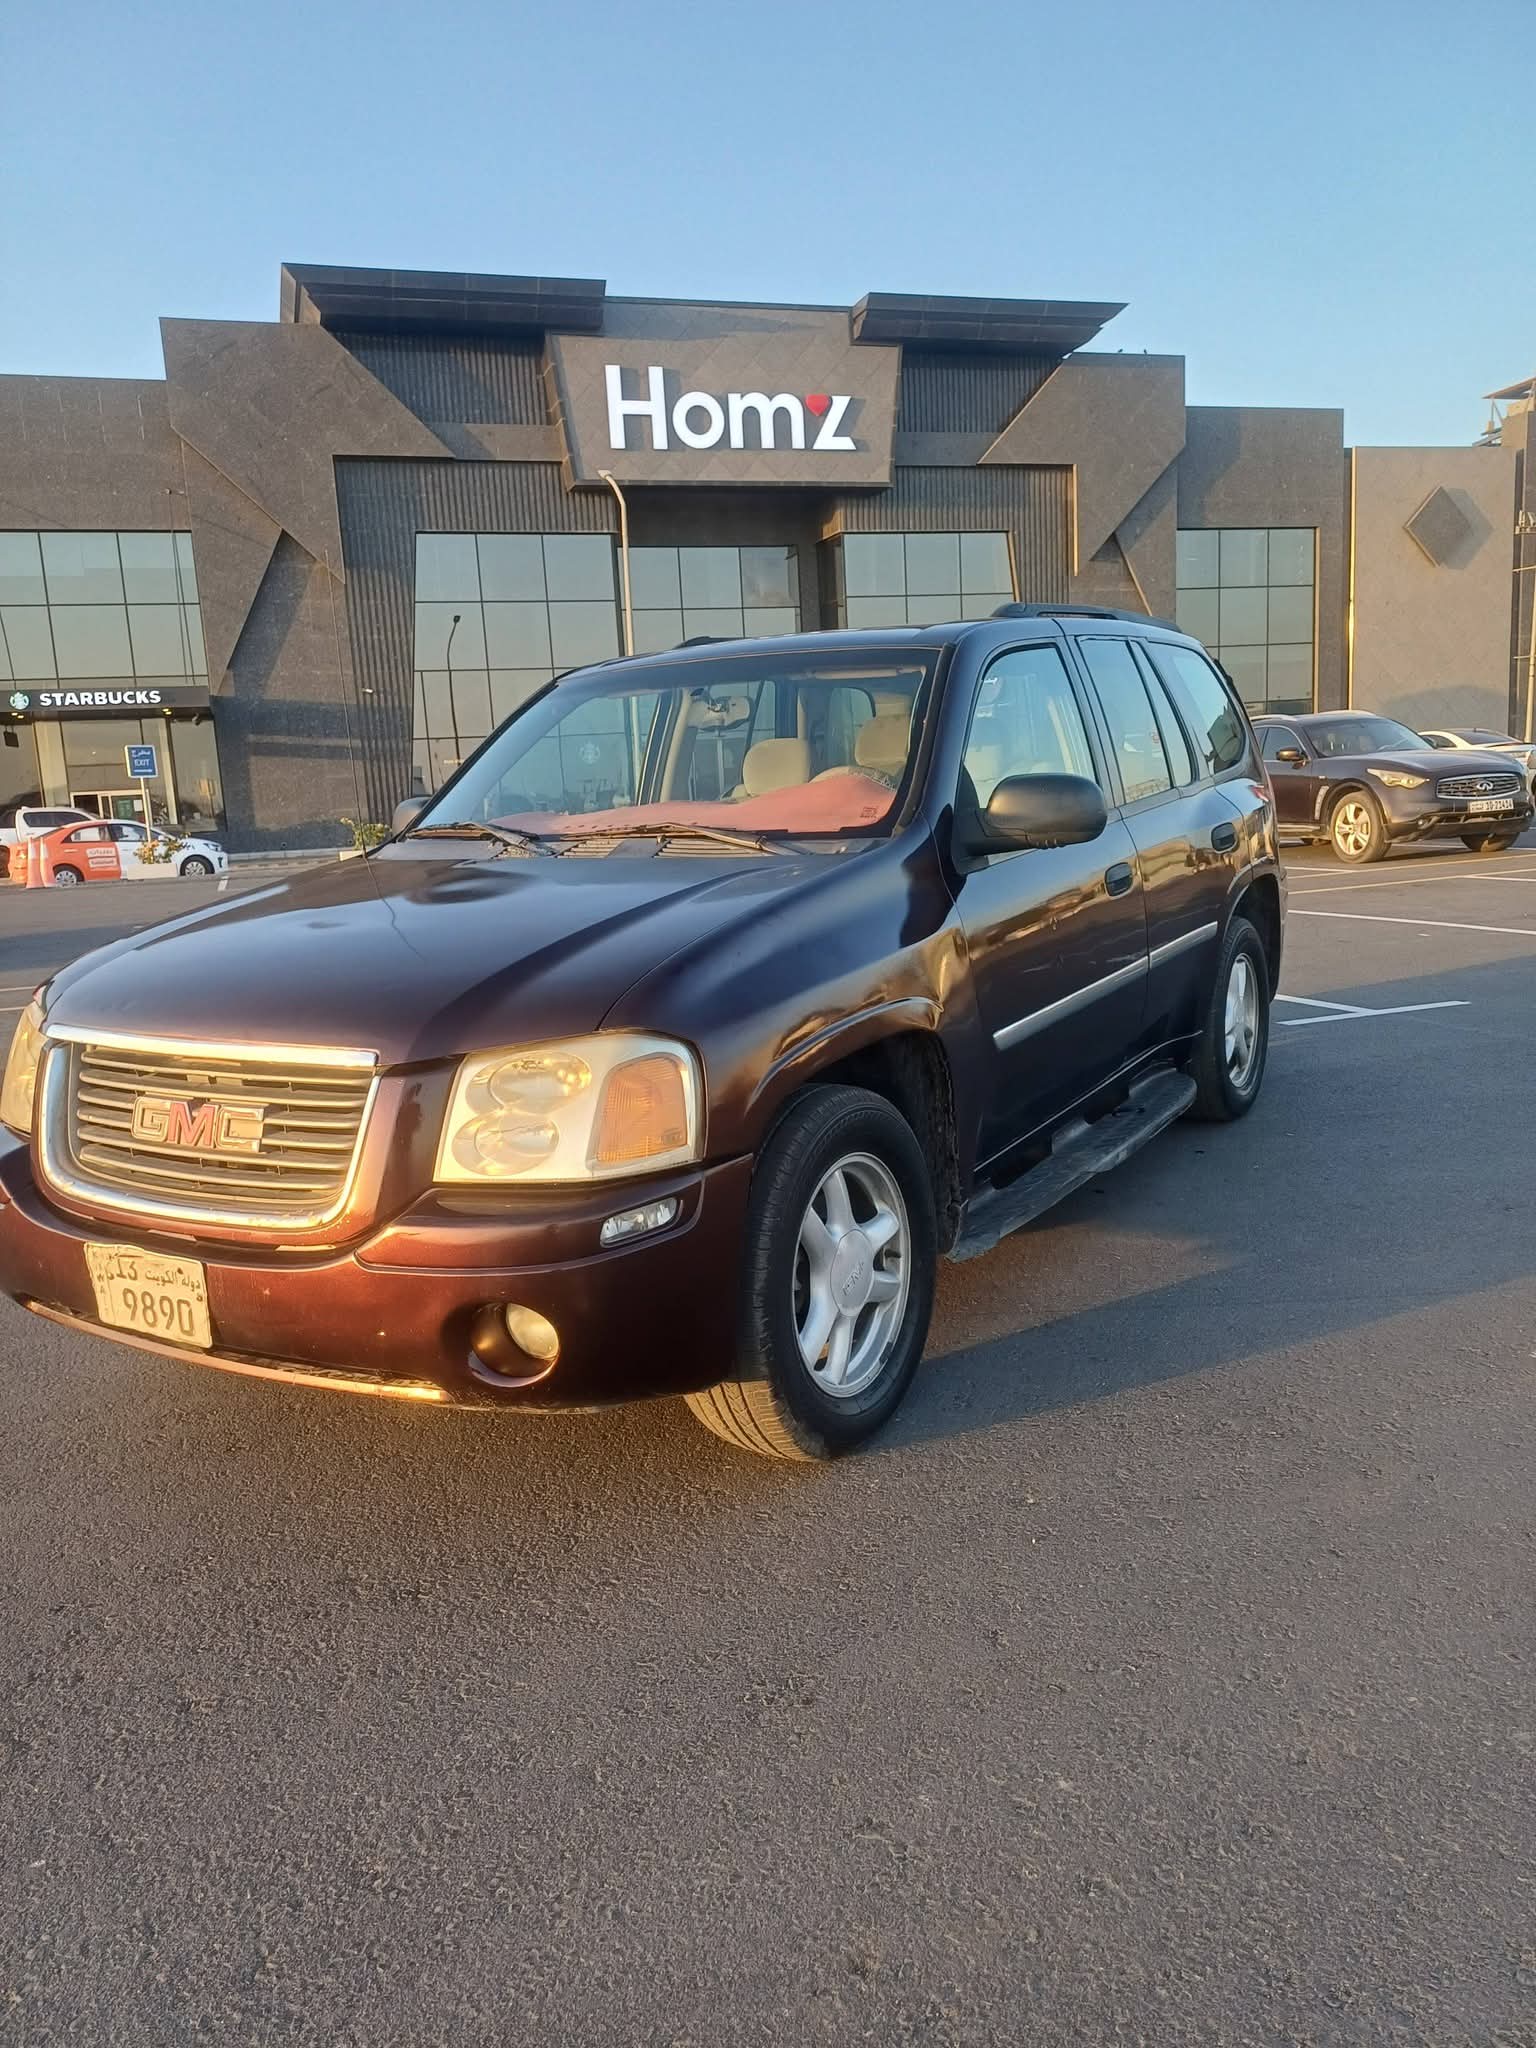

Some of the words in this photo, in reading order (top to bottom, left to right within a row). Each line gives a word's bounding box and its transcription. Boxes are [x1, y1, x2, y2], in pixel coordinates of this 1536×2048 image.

[604, 364, 857, 450] Homz
[39, 690, 161, 706] STARBUCKS
[134, 759, 150, 767] EXIT
[132, 1097, 264, 1152] GMC
[122, 1288, 194, 1336] 9890
